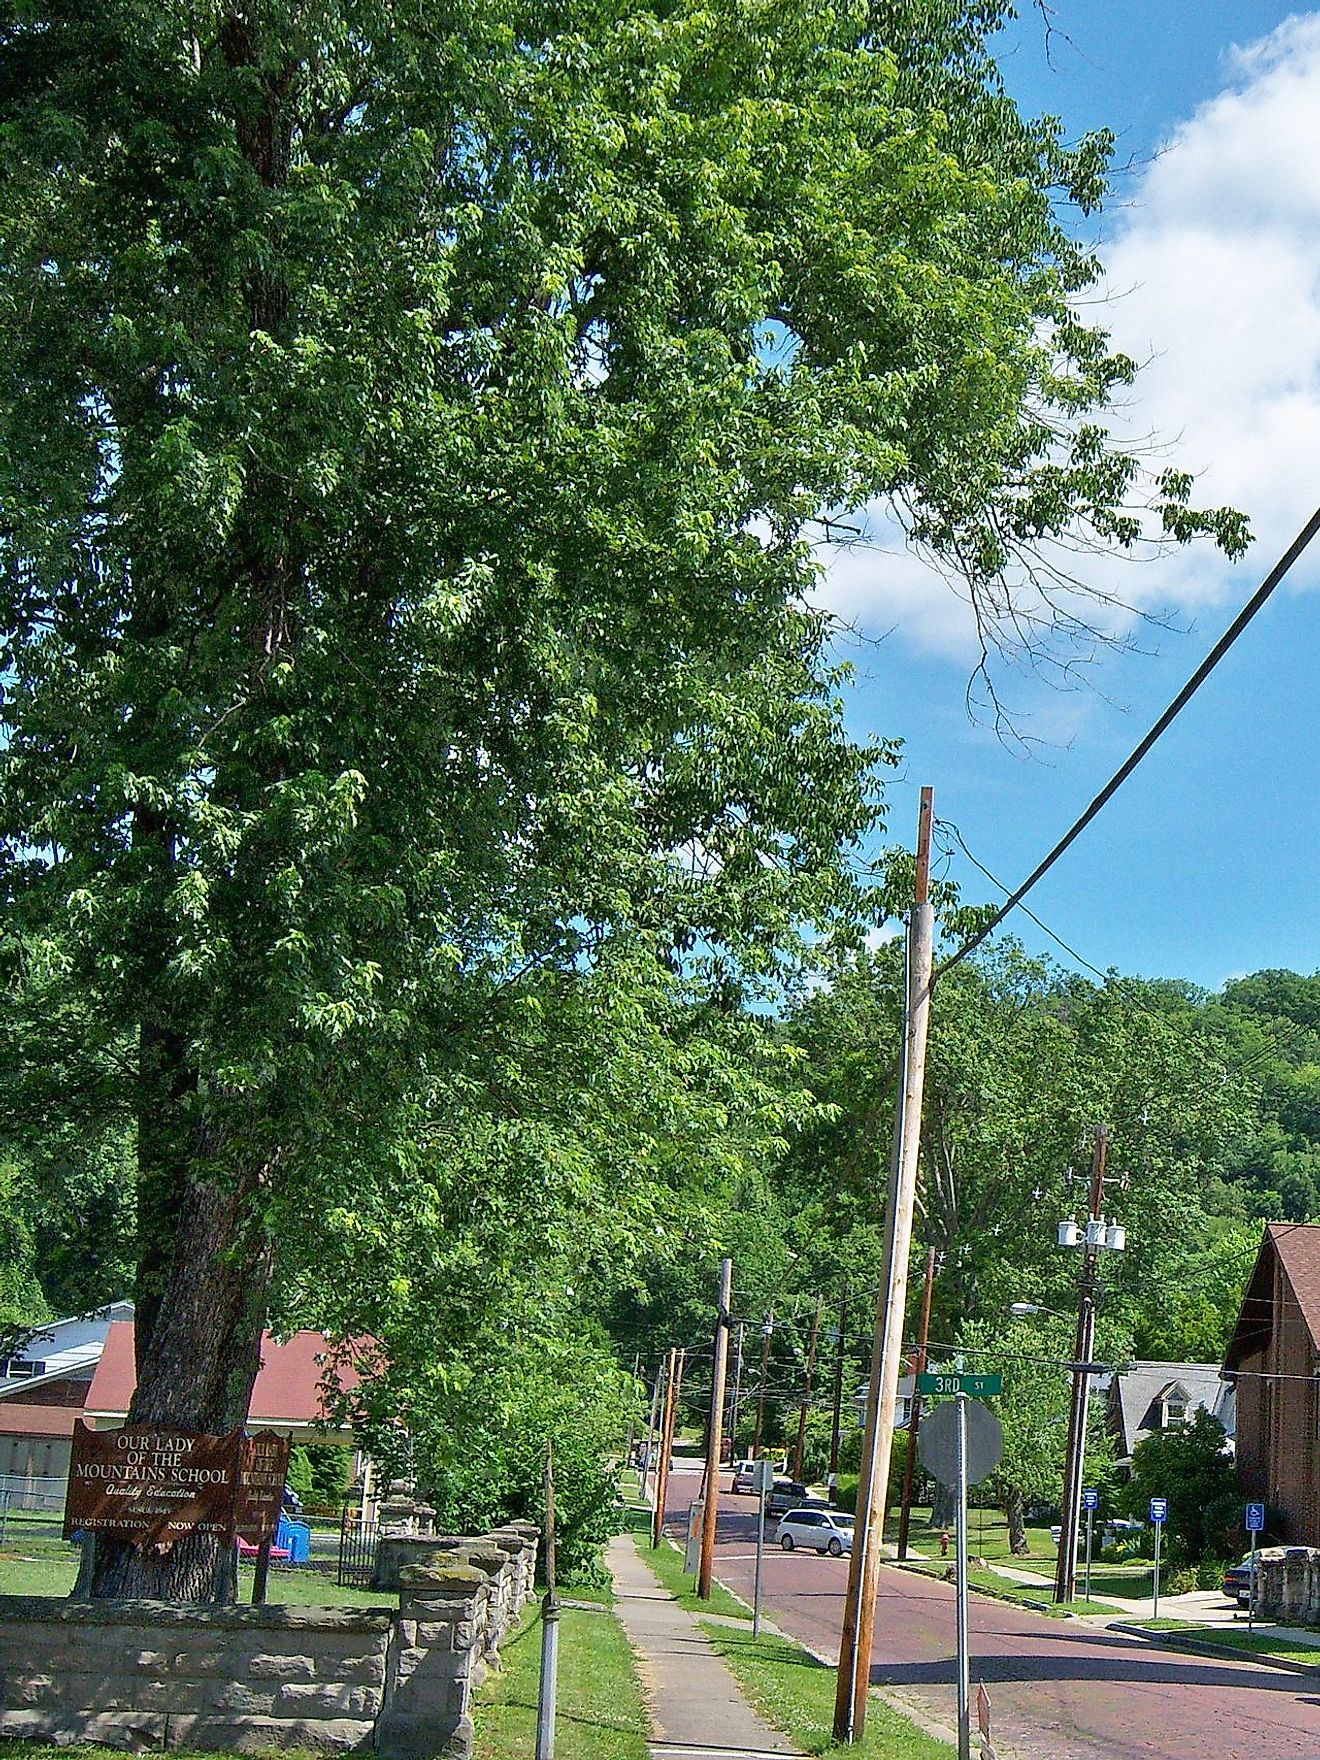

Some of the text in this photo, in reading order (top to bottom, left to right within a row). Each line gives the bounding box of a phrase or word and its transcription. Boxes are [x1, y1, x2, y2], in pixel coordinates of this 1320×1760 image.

[935, 1376, 984, 1393] 3RD ST
[117, 1435, 196, 1452] OUR LADY
[127, 1451, 182, 1467] OF THE
[76, 1463, 165, 1481] MOUNTAINS
[171, 1467, 229, 1484] SCHOOL
[106, 1483, 196, 1500] Quality Education
[71, 1517, 150, 1528] REGISTRATION
[167, 1521, 195, 1530] NOW
[197, 1522, 227, 1532] OPEN
